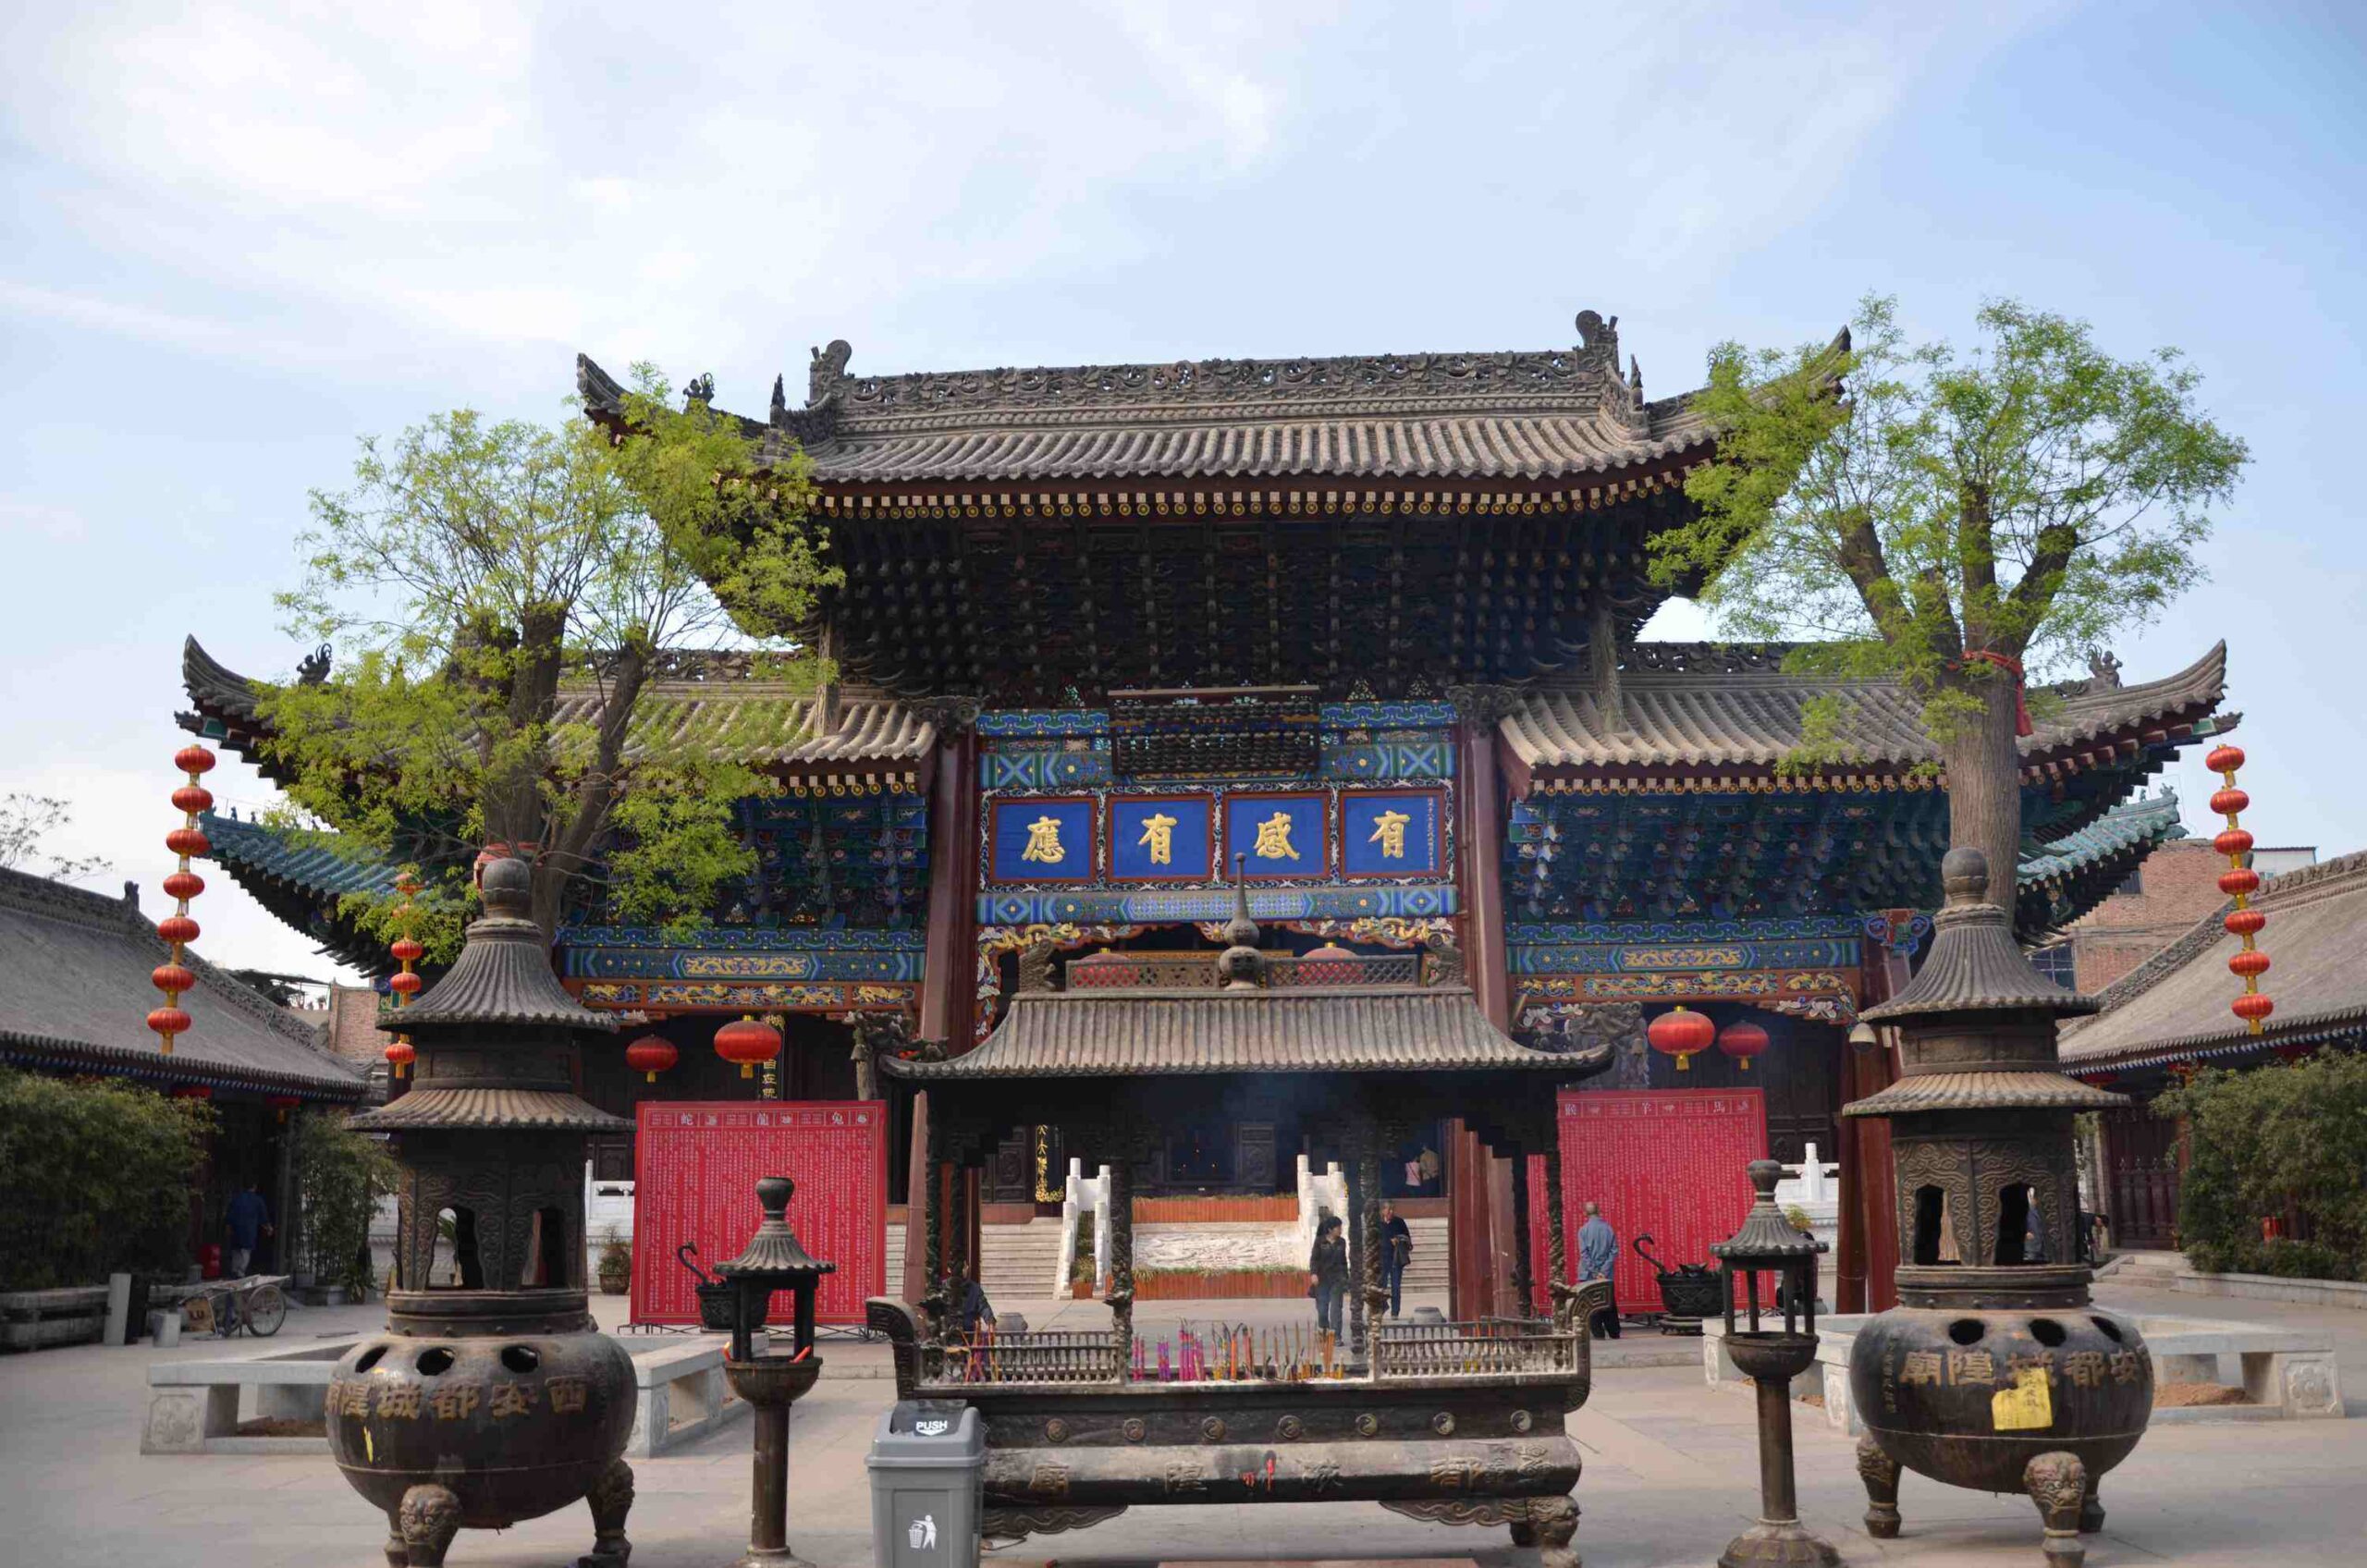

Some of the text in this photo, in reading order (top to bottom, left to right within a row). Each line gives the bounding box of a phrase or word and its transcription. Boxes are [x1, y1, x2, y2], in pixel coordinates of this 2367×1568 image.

[1021, 815, 1066, 863] 應
[1138, 813, 1178, 864] 有
[1253, 811, 1300, 861] 感
[1368, 810, 1411, 859] 有
[915, 1420, 948, 1430] PUSH
